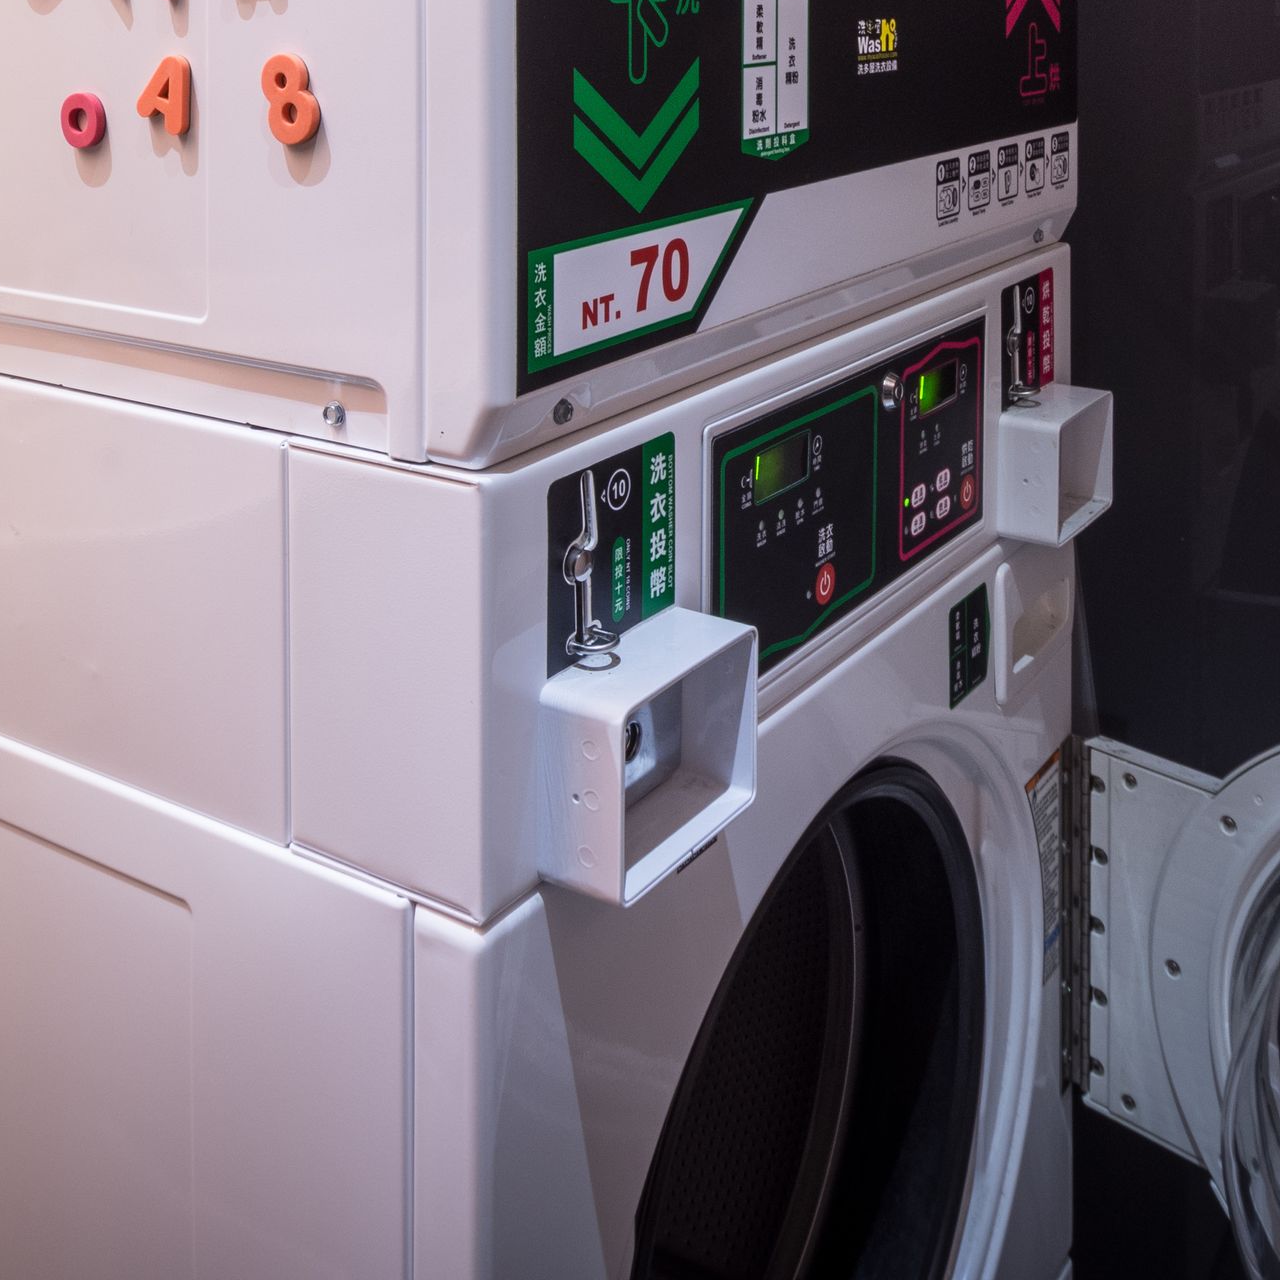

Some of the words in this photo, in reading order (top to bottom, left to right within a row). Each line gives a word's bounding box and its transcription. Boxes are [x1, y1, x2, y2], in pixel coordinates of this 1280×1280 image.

[137, 56, 191, 136] A
[262, 53, 320, 145] 8
[534, 262, 547, 358] 洗衣金額
[582, 293, 621, 331] NT.
[630, 238, 689, 313] 70
[612, 479, 626, 500] 10
[650, 452, 667, 599] 洗衣投幣
